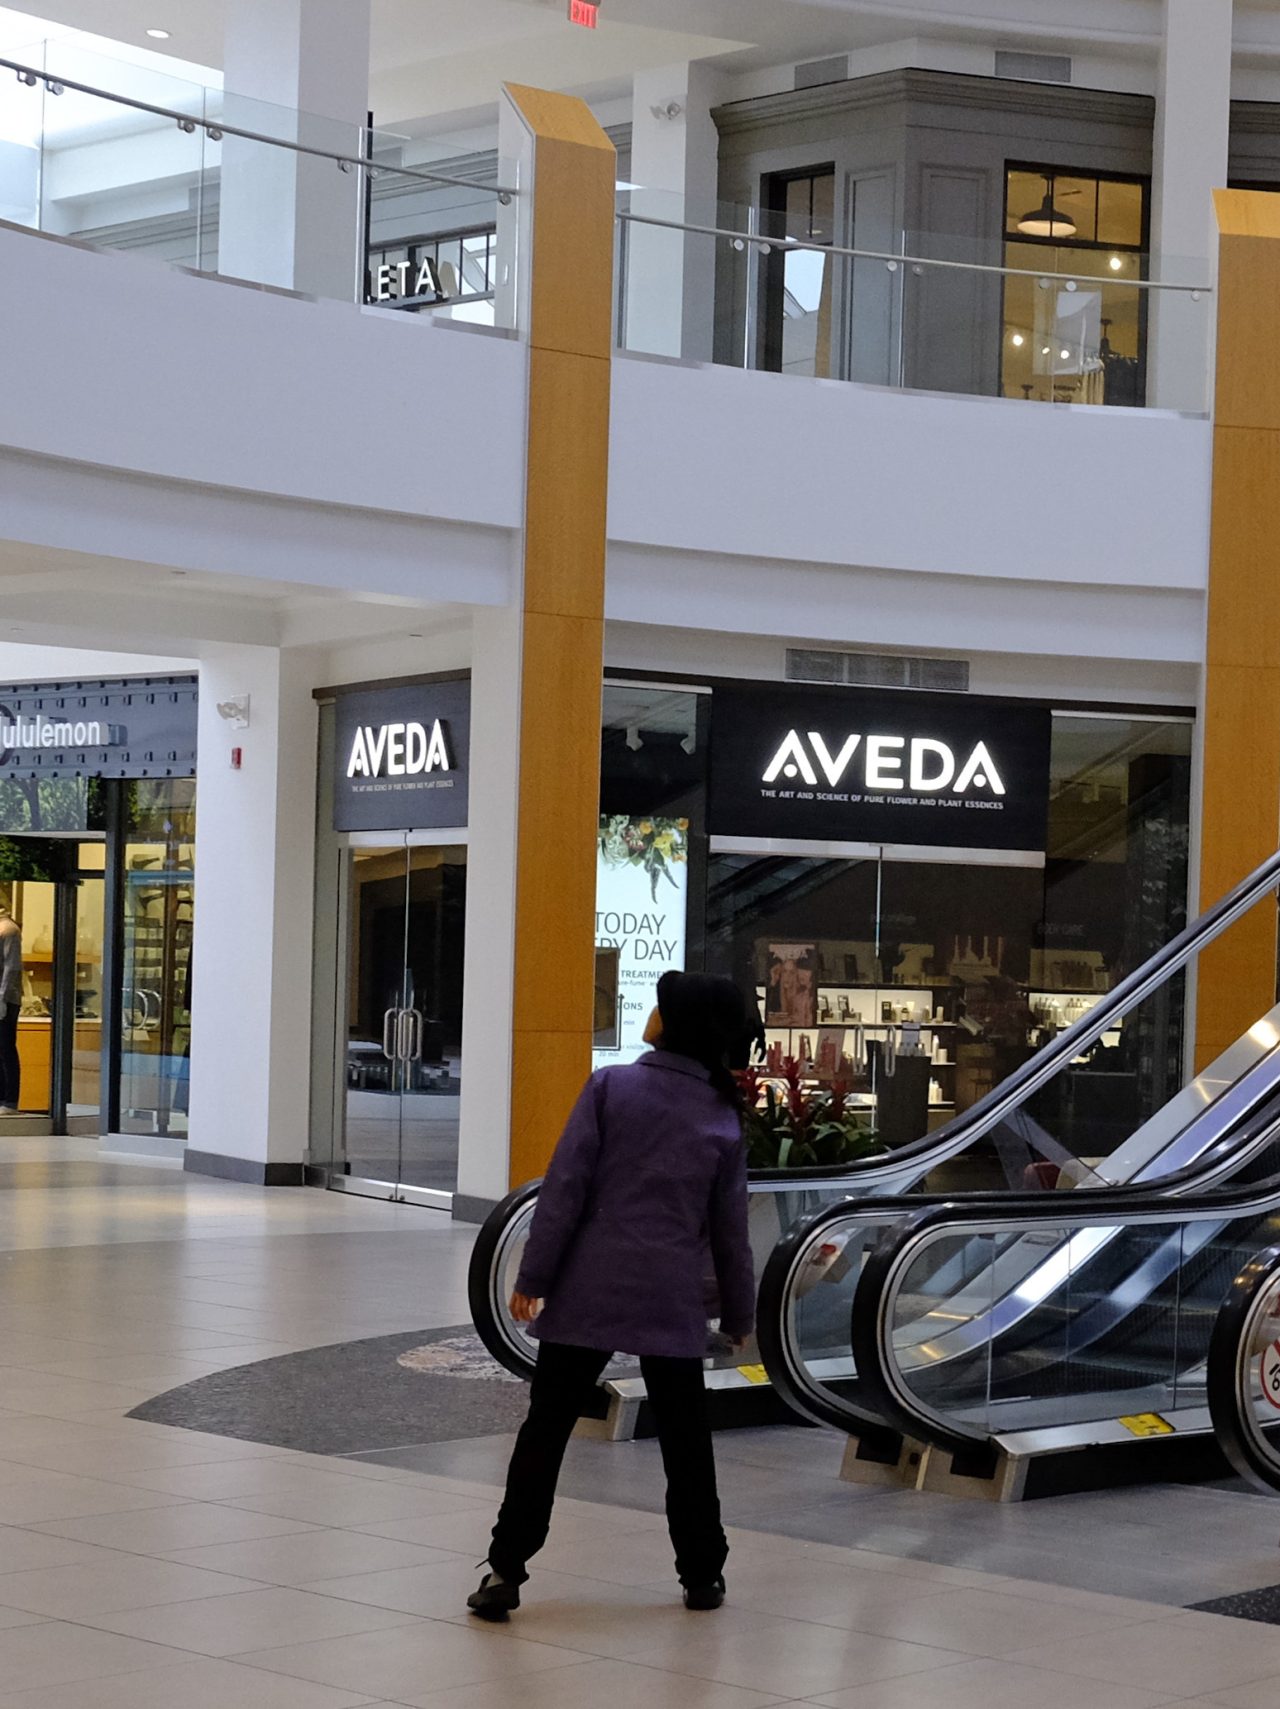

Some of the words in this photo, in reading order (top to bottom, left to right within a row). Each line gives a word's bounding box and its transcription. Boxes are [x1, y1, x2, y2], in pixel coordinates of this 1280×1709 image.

[570, 0, 599, 29] EXIT
[367, 258, 436, 301] ETA
[0, 714, 101, 749] ululemon
[347, 718, 449, 778] AVEDA
[762, 729, 1006, 795] AVEDA
[760, 789, 777, 798] THE
[780, 790, 796, 799] ART
[797, 791, 814, 800] AND
[816, 792, 849, 802] SCIENCE
[851, 794, 862, 803] OF
[864, 795, 885, 804] PURE
[887, 796, 918, 806] FLOWER
[919, 798, 937, 807] AND
[938, 799, 962, 808] PLANT
[595, 912, 666, 935] TODAY
[634, 939, 677, 961] DAY
[620, 969, 665, 979] TREATME
